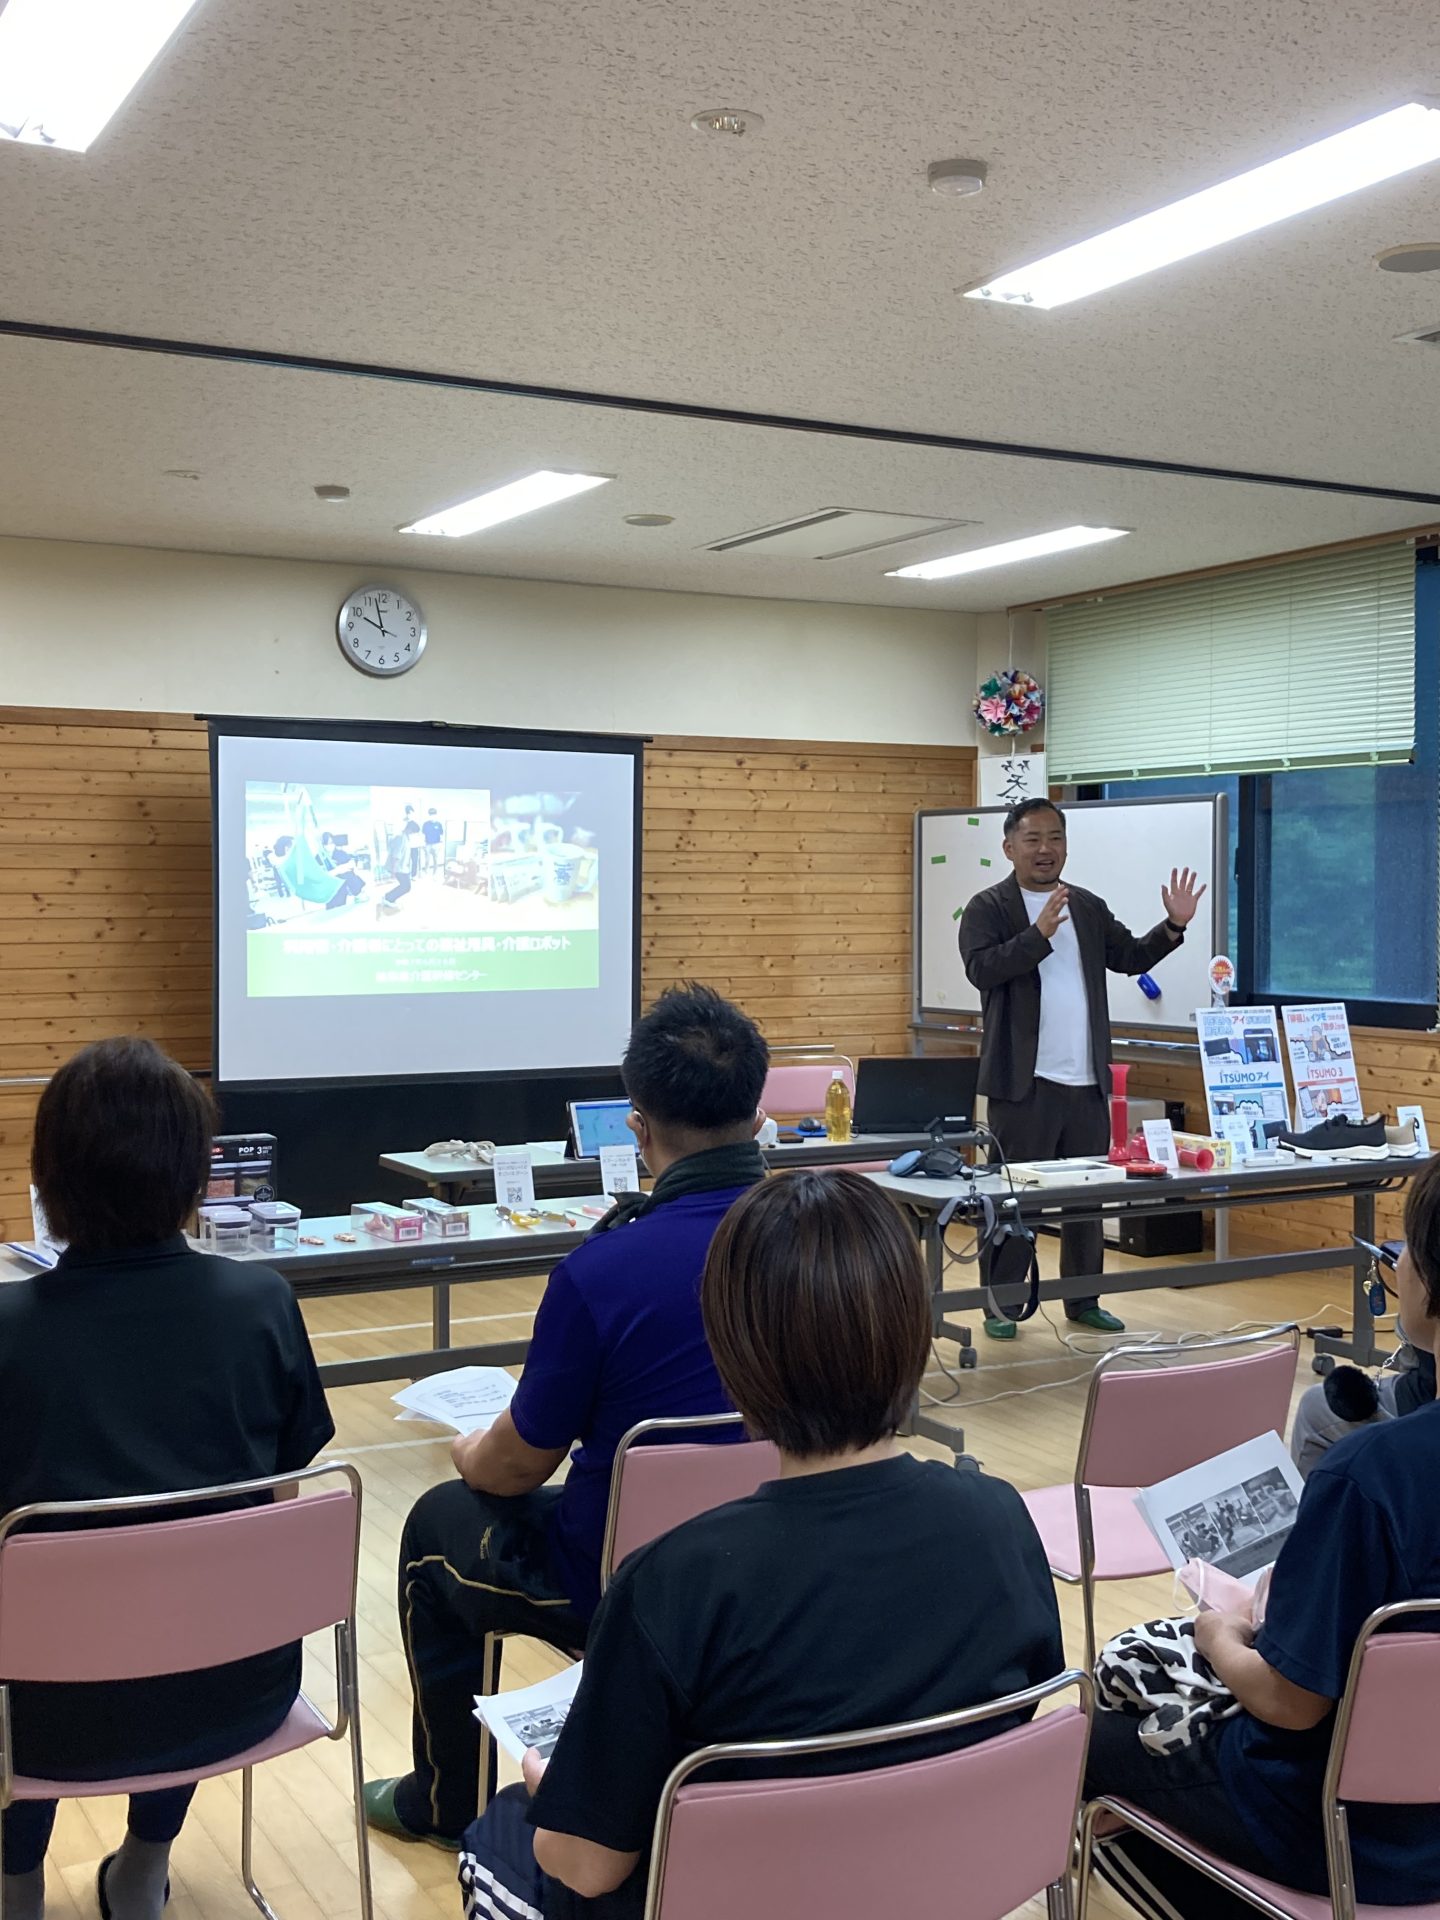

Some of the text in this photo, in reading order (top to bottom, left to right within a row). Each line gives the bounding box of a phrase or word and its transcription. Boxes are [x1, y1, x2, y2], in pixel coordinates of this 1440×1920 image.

[364, 597, 372, 607] 11
[378, 594, 388, 604] 12
[396, 600, 400, 610] 1
[352, 607, 363, 618] 10
[405, 612, 412, 622] 2
[348, 622, 355, 632] 9
[410, 628, 416, 638] 3
[353, 638, 360, 648] 8
[404, 644, 411, 652] 4
[365, 650, 372, 660] 7
[393, 653, 400, 663] 5
[378, 656, 385, 665] 6
[1338, 1066, 1344, 1077] 3
[238, 1146, 255, 1154] POP
